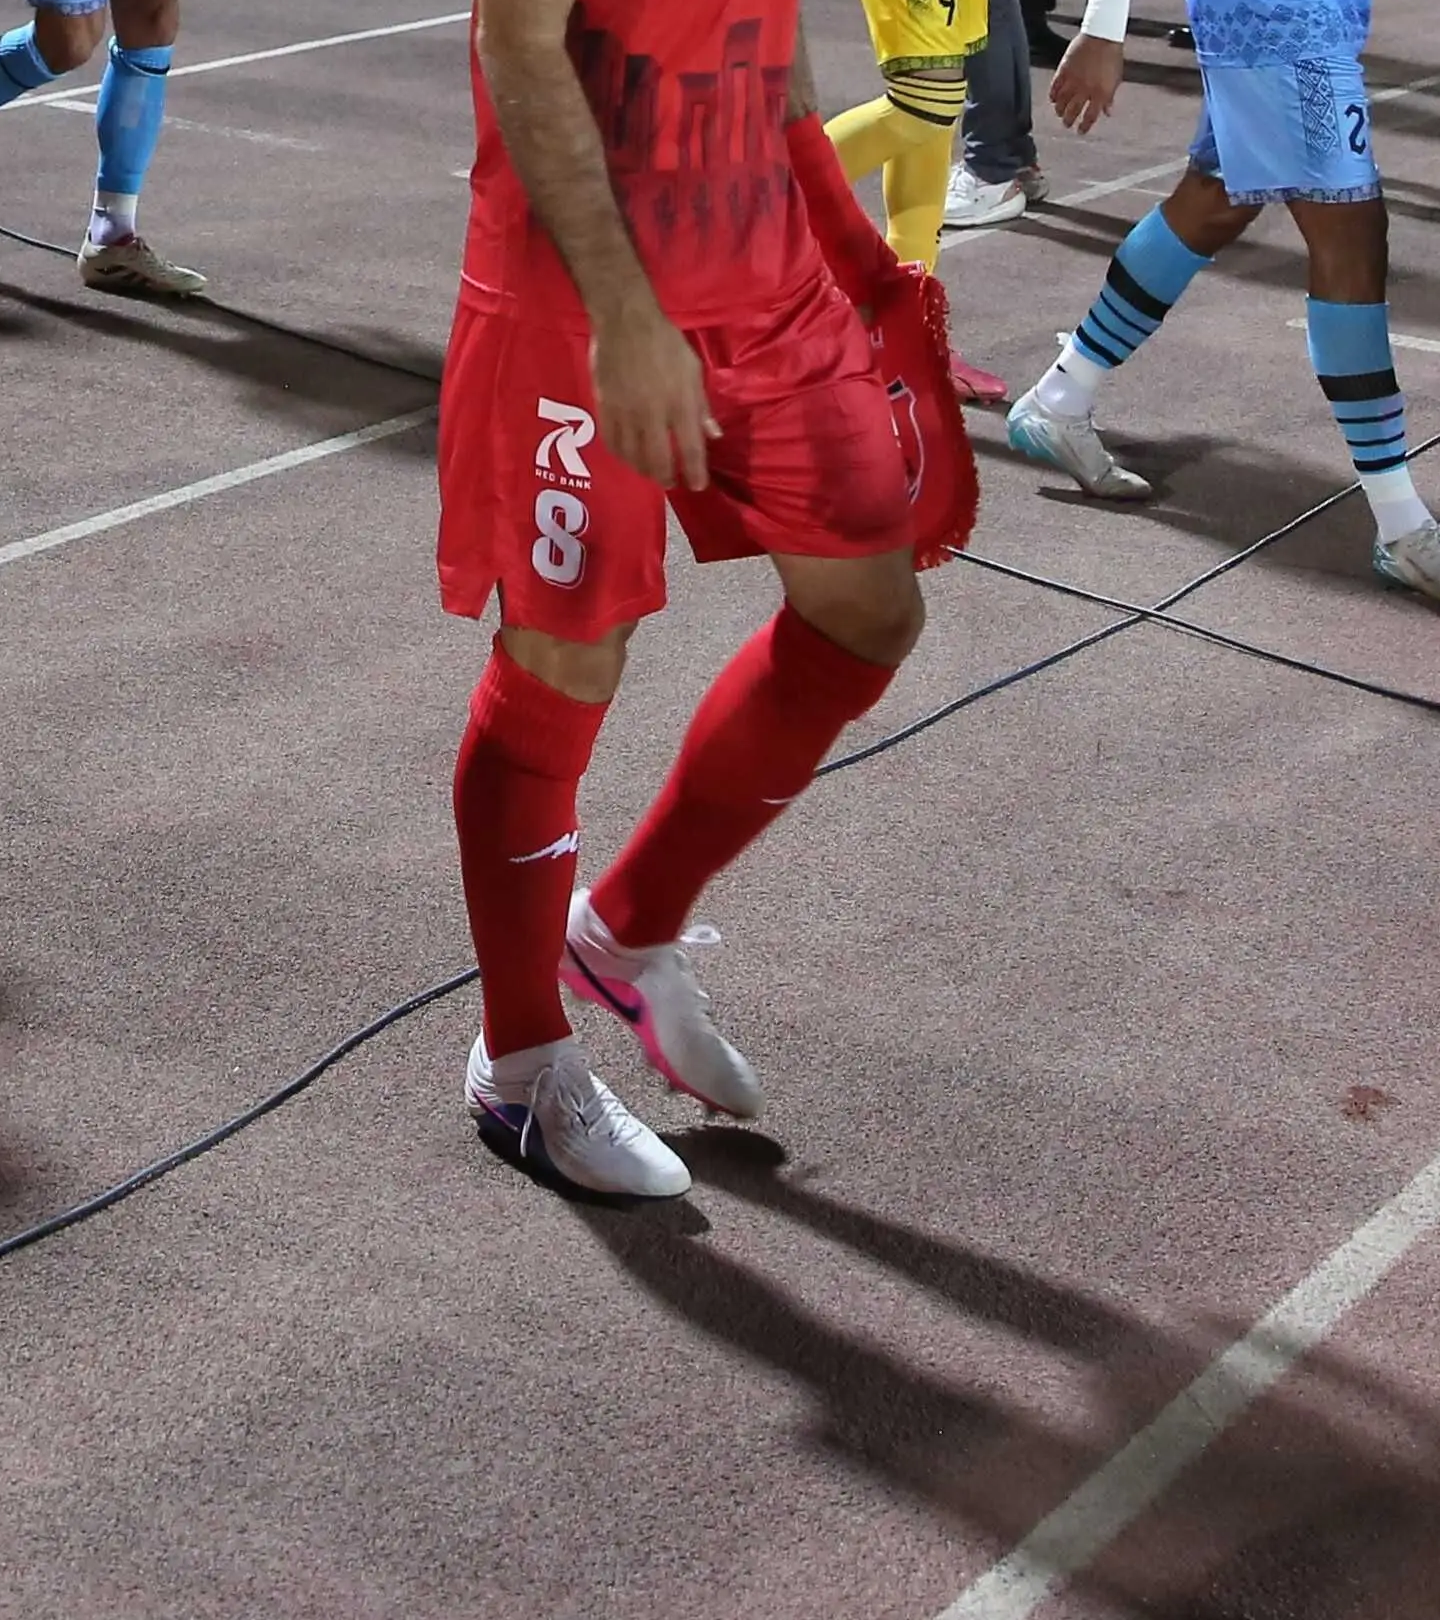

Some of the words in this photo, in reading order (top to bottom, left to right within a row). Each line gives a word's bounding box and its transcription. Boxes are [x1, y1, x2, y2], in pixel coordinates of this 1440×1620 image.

[1344, 104, 1367, 155] 2
[535, 468, 556, 482] RED
[560, 476, 592, 490] BANK
[532, 488, 589, 590] 8
